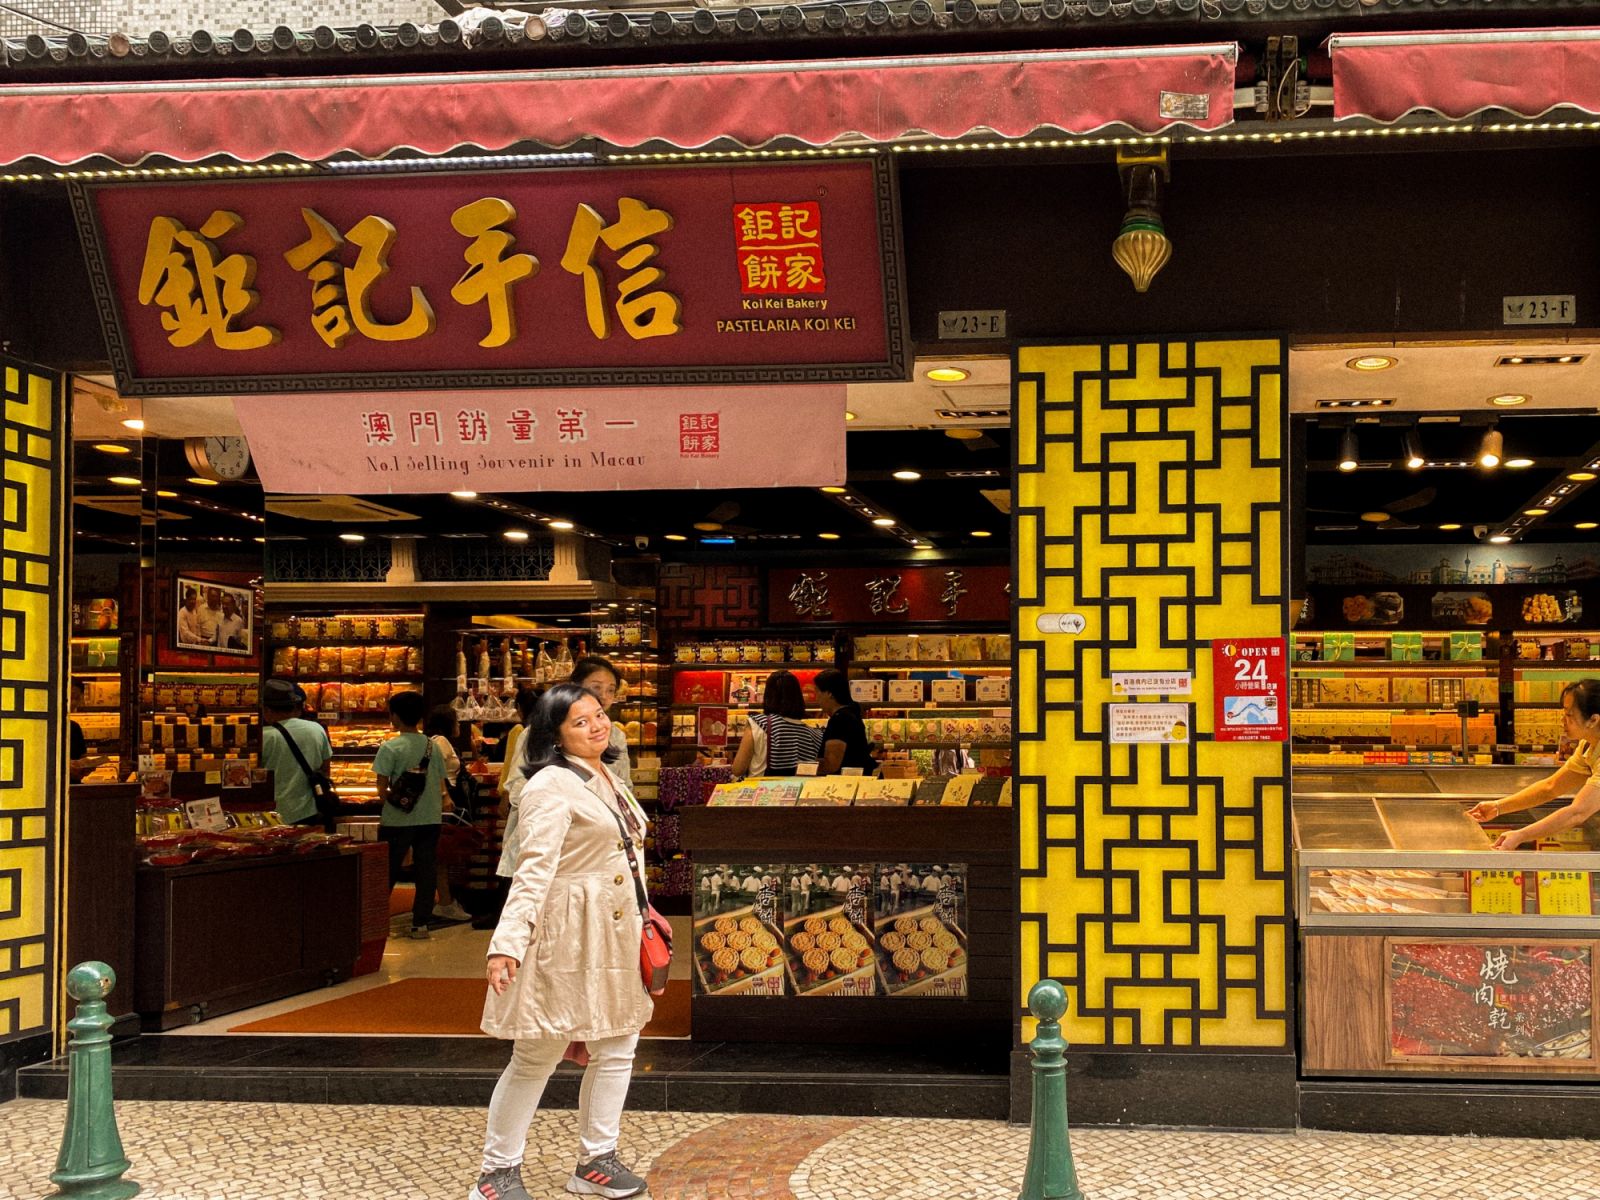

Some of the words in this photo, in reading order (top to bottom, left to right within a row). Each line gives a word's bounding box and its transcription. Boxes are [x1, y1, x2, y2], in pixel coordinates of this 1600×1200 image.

[737, 206, 818, 241] 鉅記
[138, 197, 684, 351] 鉅記手信
[743, 253, 822, 289] 餅家
[742, 299, 763, 310] Koi
[765, 298, 784, 309] Kei
[786, 298, 828, 310] Bakery
[1528, 300, 1570, 319] 23-F
[716, 319, 801, 333] PASTELARIA
[804, 318, 830, 331] KOI
[834, 317, 856, 330] KEI
[960, 315, 1000, 333] 23-E
[361, 408, 636, 444] 澳門銷量第一
[682, 415, 718, 430] 鉅記
[236, 439, 241, 447] 2
[682, 435, 718, 450] 餅家
[238, 450, 243, 458] 3
[407, 454, 469, 475] Selling
[478, 453, 555, 469] Souvenir
[563, 454, 582, 468] in
[591, 451, 646, 467] Macau
[788, 571, 1010, 616] 鉅記手
[1241, 647, 1268, 657] OPEN
[1234, 658, 1269, 690] 24
[1475, 948, 1519, 1030] 燒肉乾
